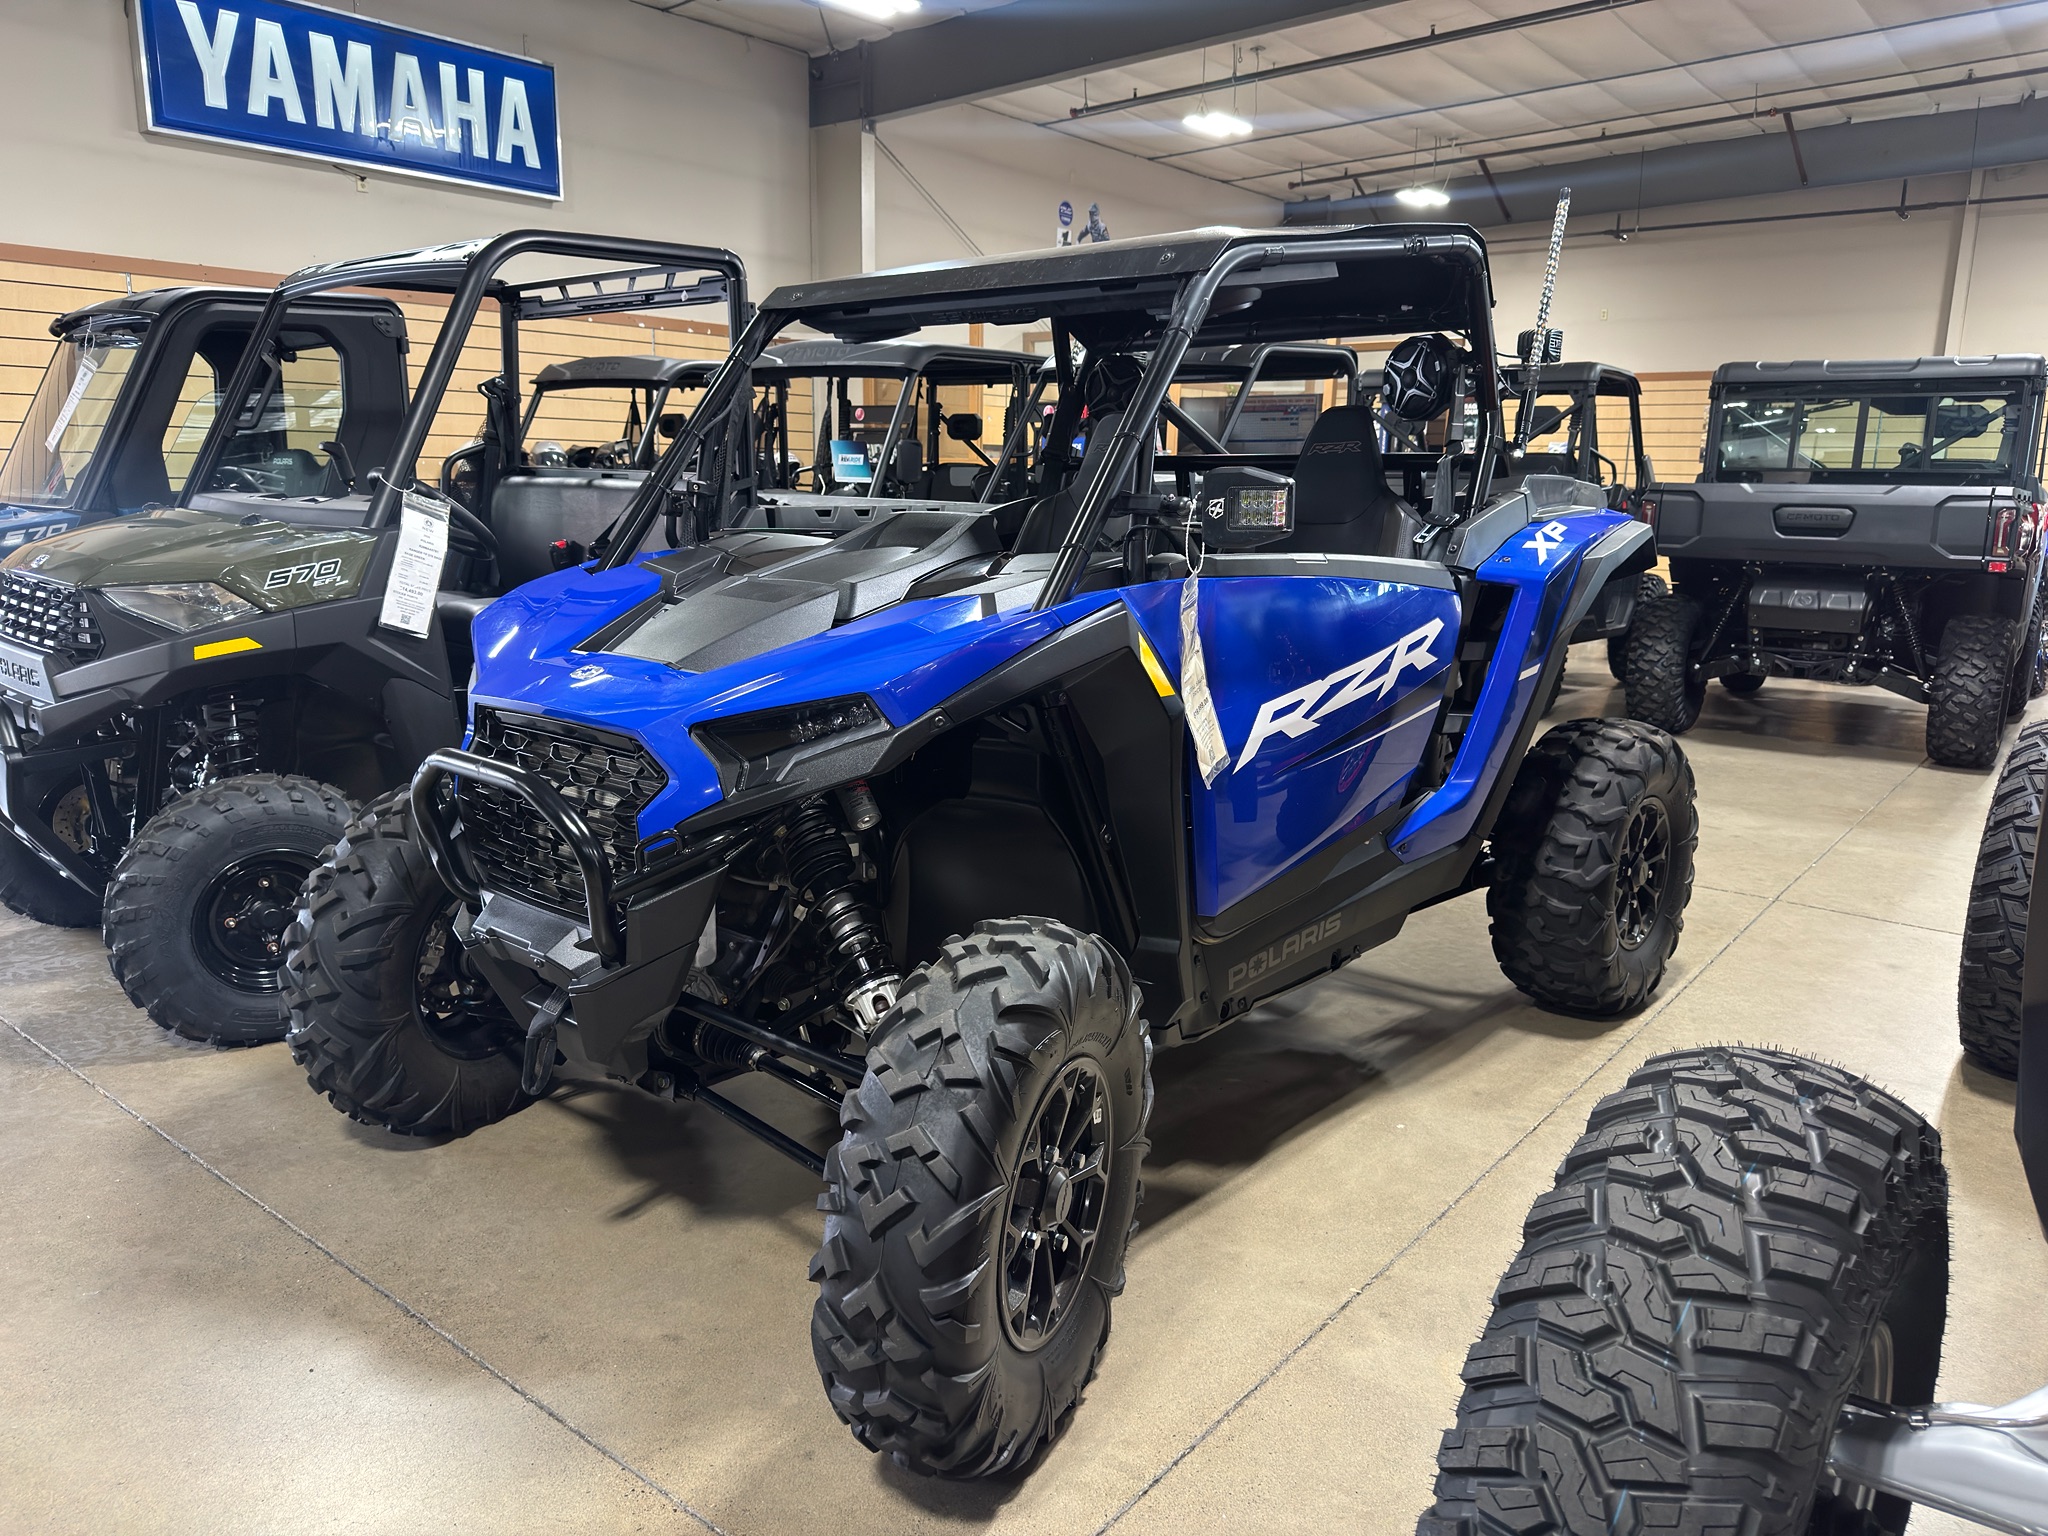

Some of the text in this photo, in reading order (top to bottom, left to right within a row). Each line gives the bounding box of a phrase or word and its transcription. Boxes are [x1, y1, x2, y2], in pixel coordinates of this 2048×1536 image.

[176, 0, 541, 169] YAMAHA
[3, 523, 68, 546] 570
[1787, 513, 1840, 522] CFMOTO
[1522, 521, 1568, 566] XP
[263, 558, 341, 590] 570
[312, 575, 341, 587] EFI
[1233, 618, 1445, 775] RZR
[1228, 912, 1341, 991] POLARIS
